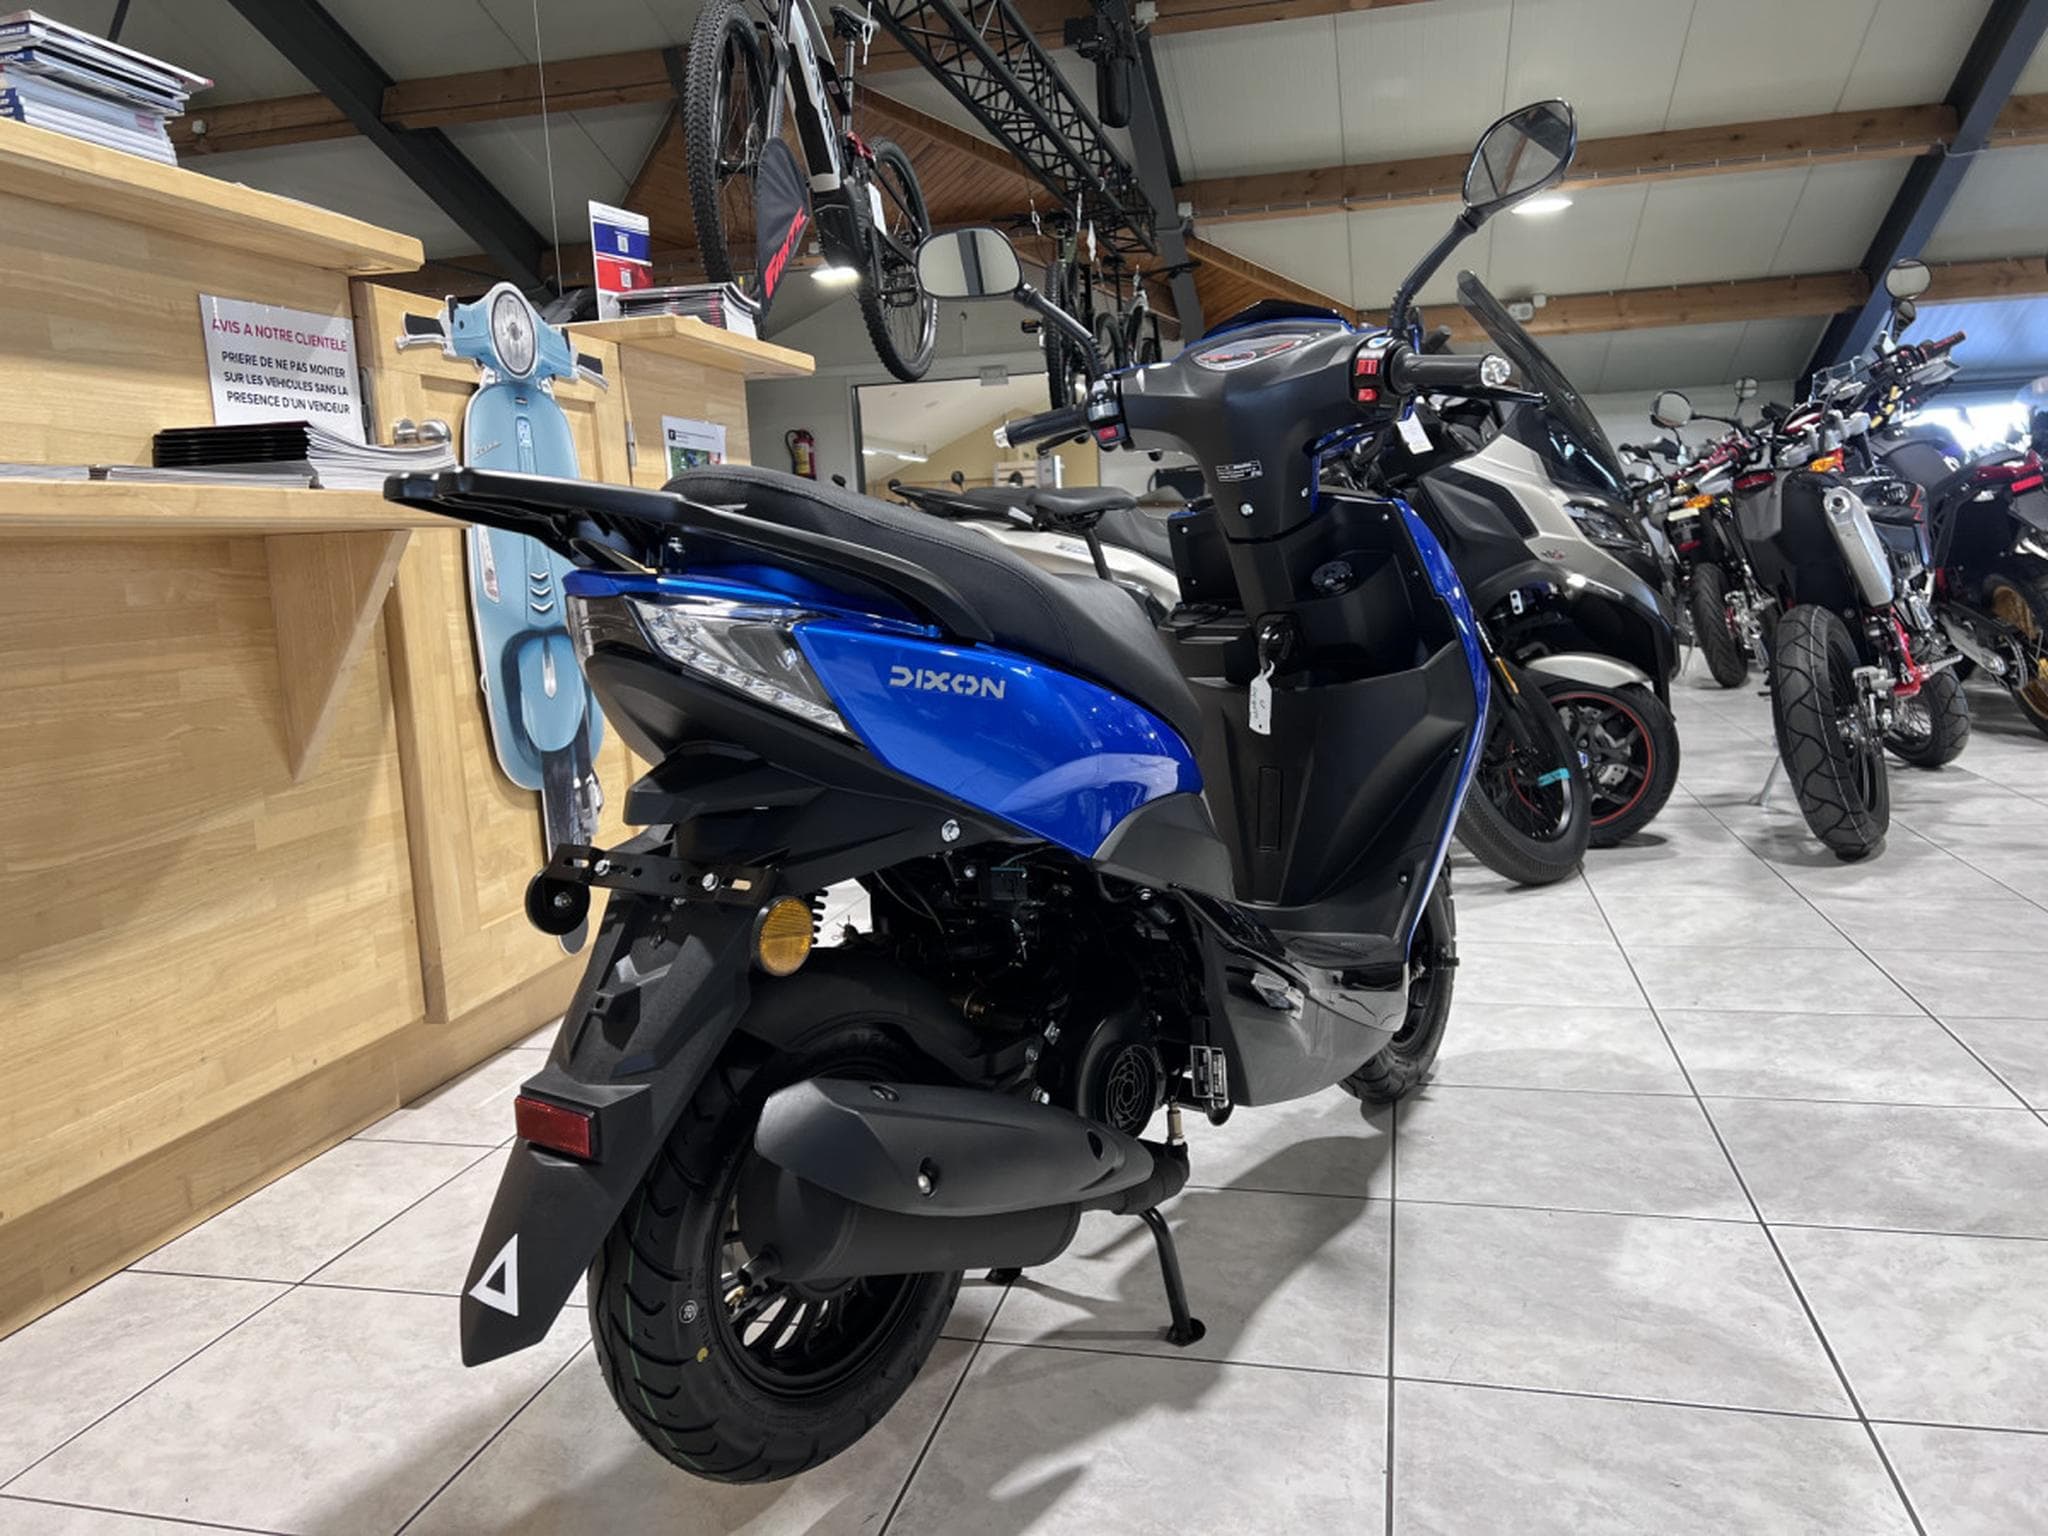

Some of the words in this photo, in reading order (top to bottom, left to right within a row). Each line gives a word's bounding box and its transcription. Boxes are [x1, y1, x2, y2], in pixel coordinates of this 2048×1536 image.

[212, 319, 239, 334] AVIS
[256, 325, 292, 342] NOTRE
[295, 332, 347, 352] CLIENTELE
[222, 351, 258, 366] PRIERE
[260, 356, 273, 368] DE
[275, 359, 288, 370] NE
[289, 360, 308, 373] PAS
[310, 364, 345, 378] MONTER
[224, 372, 244, 384] SUR
[246, 374, 263, 386] LES
[265, 376, 312, 391] VEHICULES
[315, 383, 336, 395] SANS
[338, 385, 349, 396] LA
[227, 391, 281, 407] PRESENCE
[281, 396, 307, 410] D'UN
[307, 400, 350, 414] VENDEUR
[889, 664, 1006, 700] DIXON
